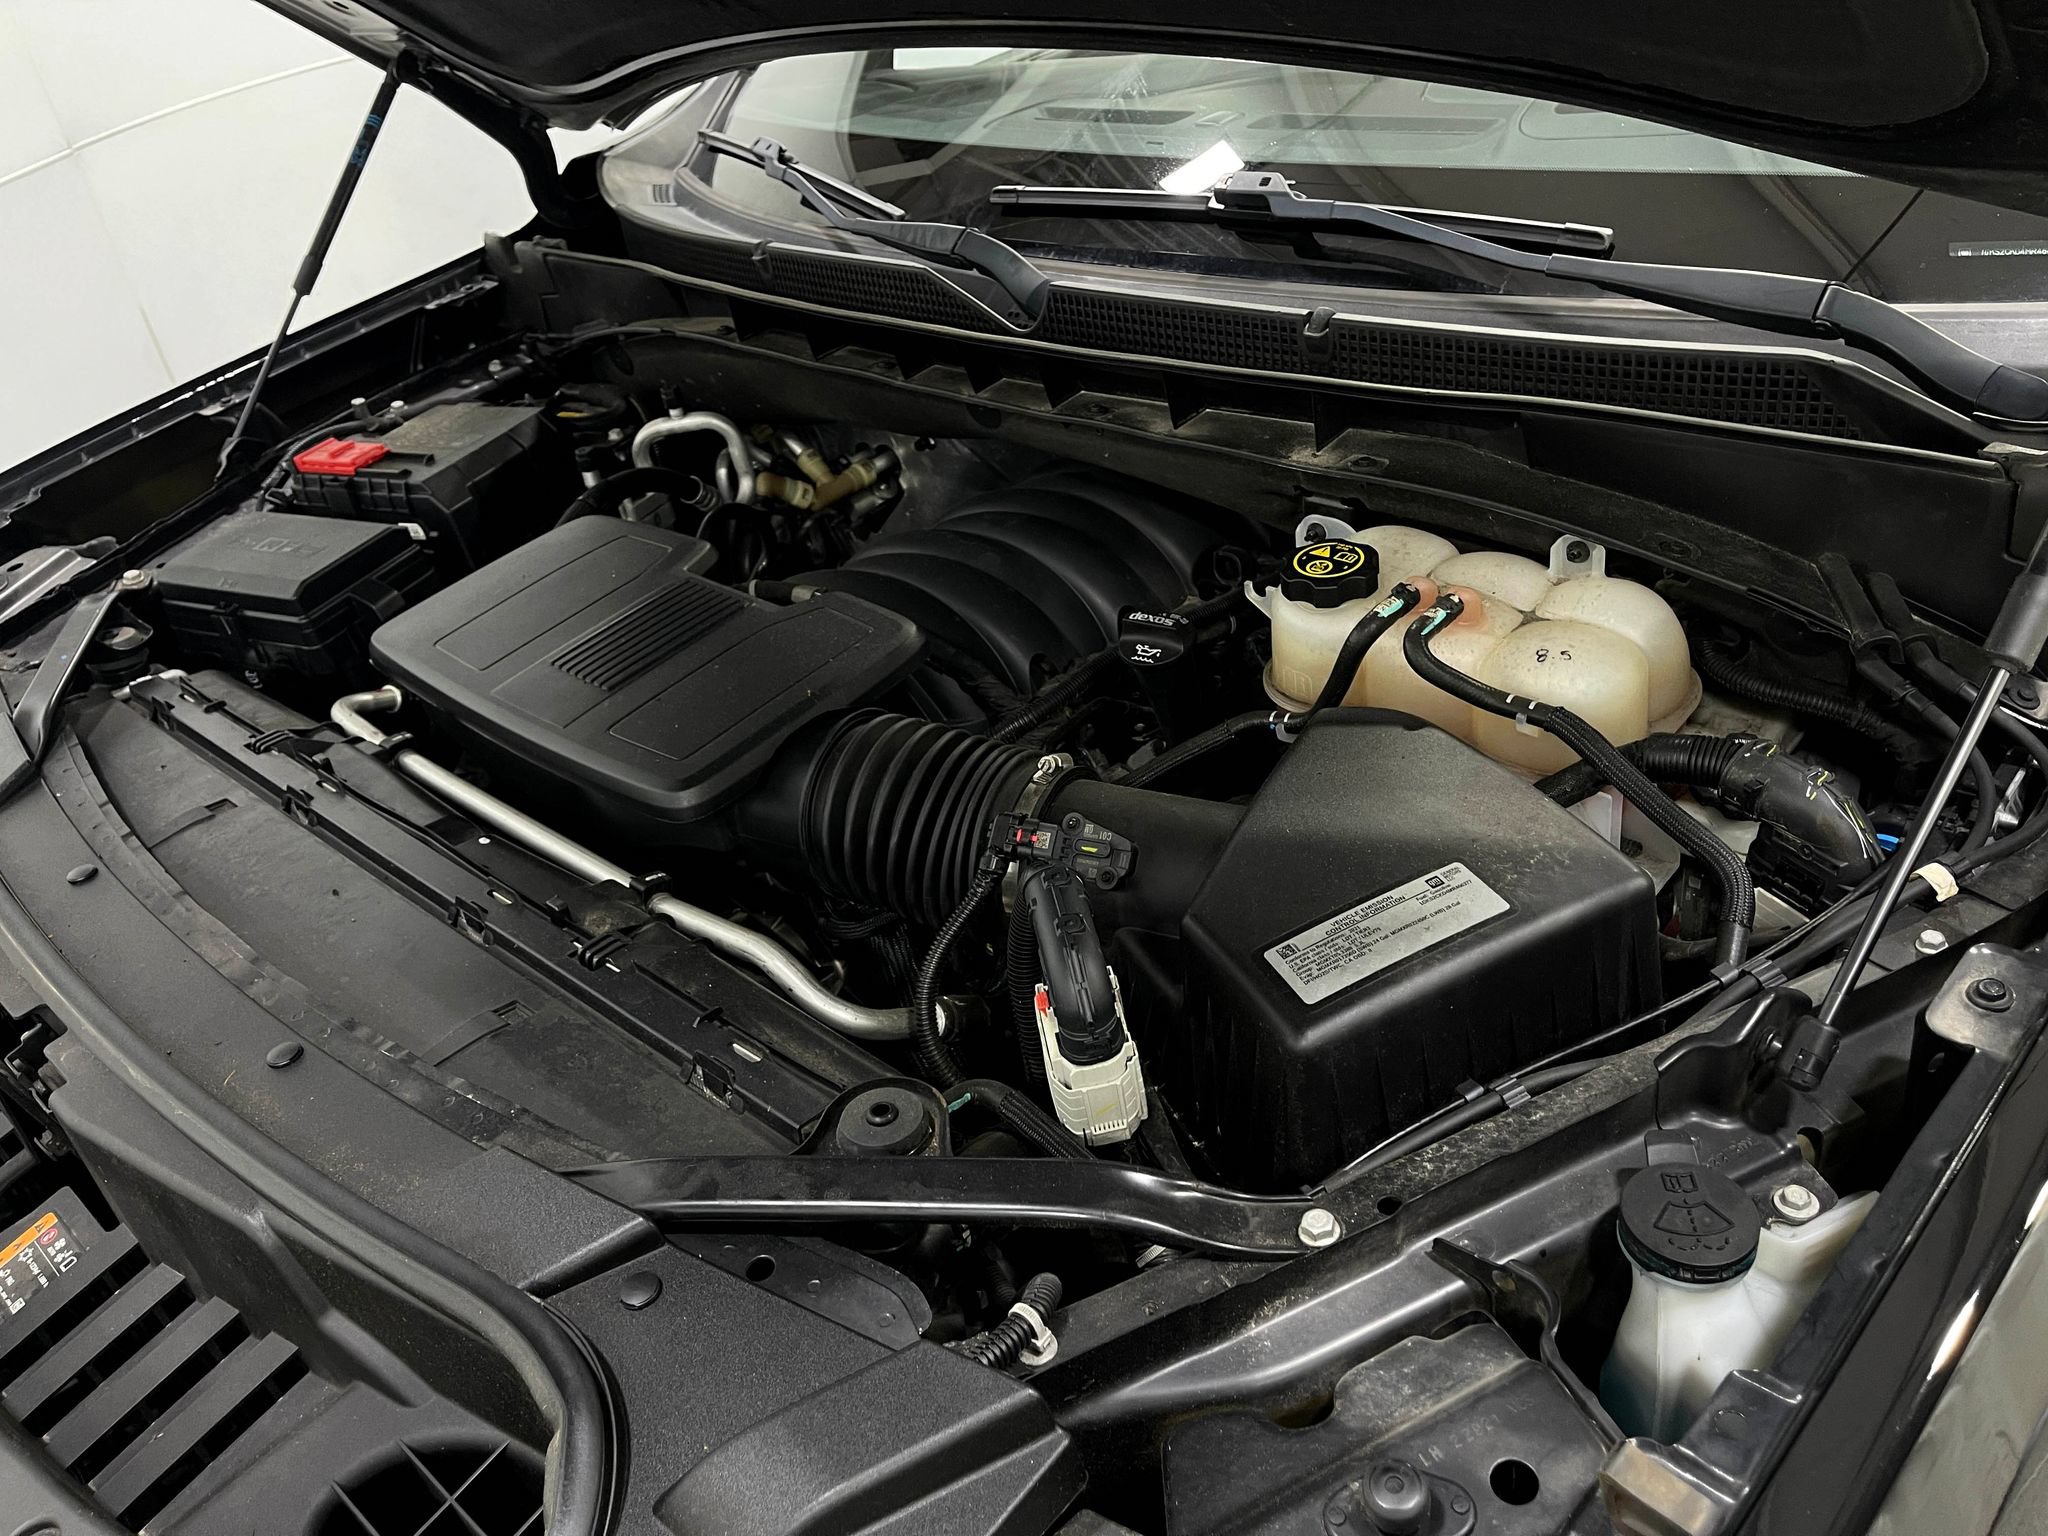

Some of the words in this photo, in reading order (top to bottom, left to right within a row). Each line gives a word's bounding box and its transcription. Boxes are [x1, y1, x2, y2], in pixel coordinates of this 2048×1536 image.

[1128, 611, 1176, 626] dexos
[1325, 918, 1359, 935] CONTROL
[1358, 895, 1405, 919] INFORMATION
[1329, 910, 1360, 926] VEHICLE
[1359, 894, 1393, 912] EMISSION
[1299, 955, 1310, 963] EPA
